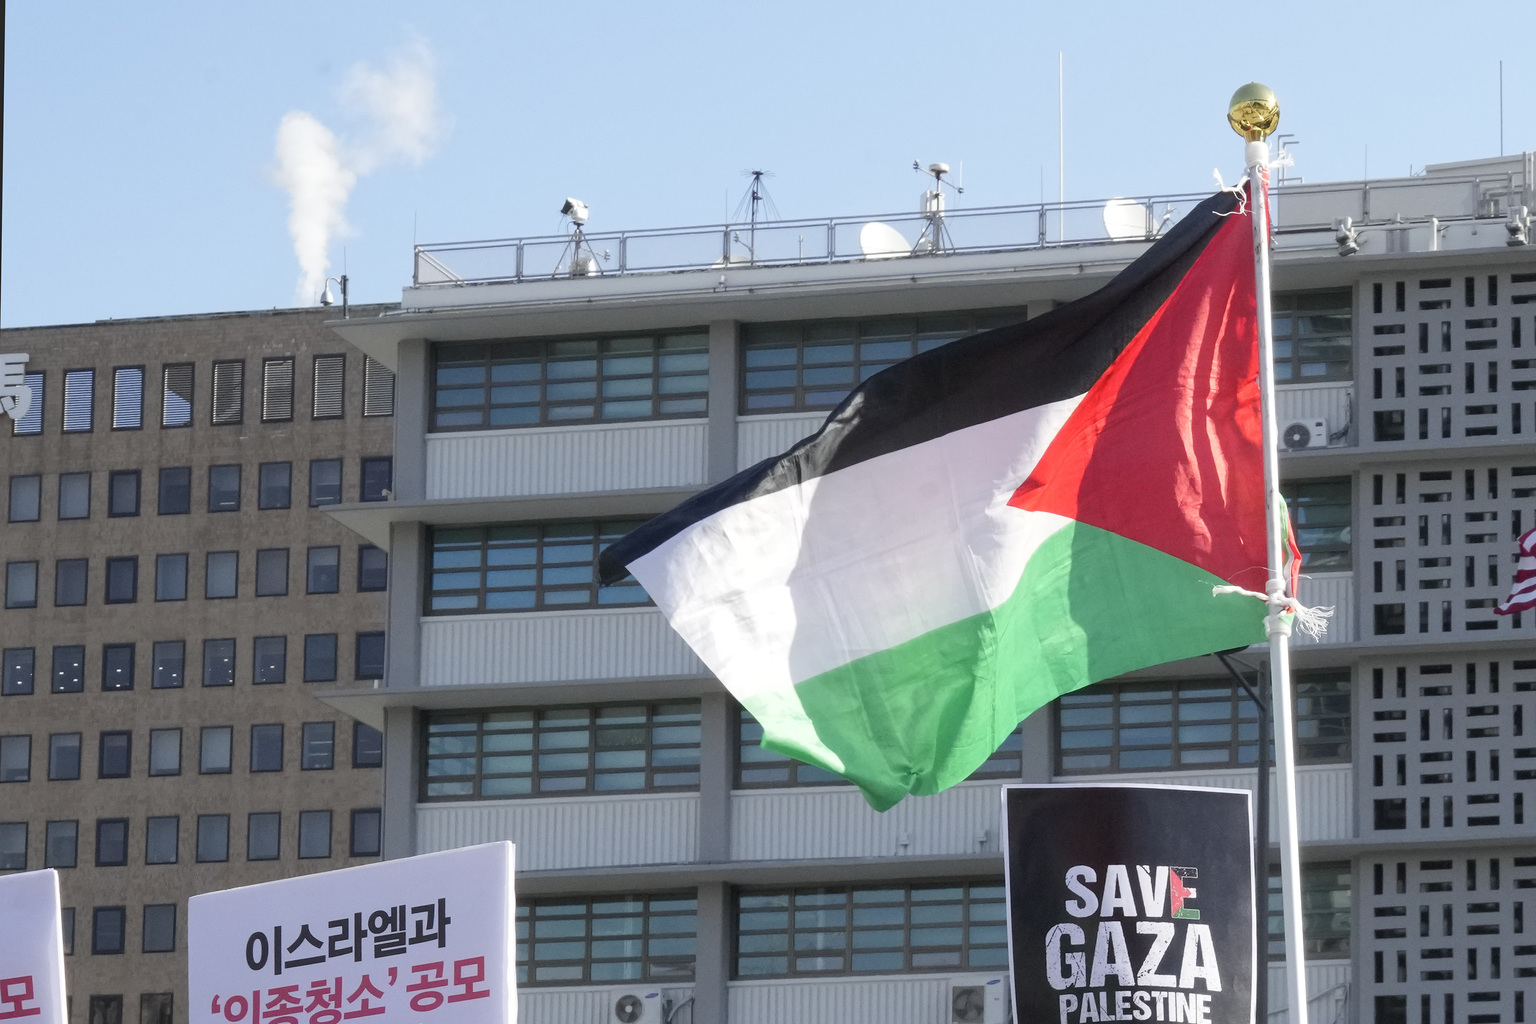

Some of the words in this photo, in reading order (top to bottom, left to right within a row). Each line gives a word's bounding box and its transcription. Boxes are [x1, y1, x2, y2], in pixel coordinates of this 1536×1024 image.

[1065, 864, 1201, 920] SAVE
[245, 897, 451, 976] 이스라엘과
[1045, 921, 1223, 992] GAZA
[405, 955, 491, 1014] 공모
